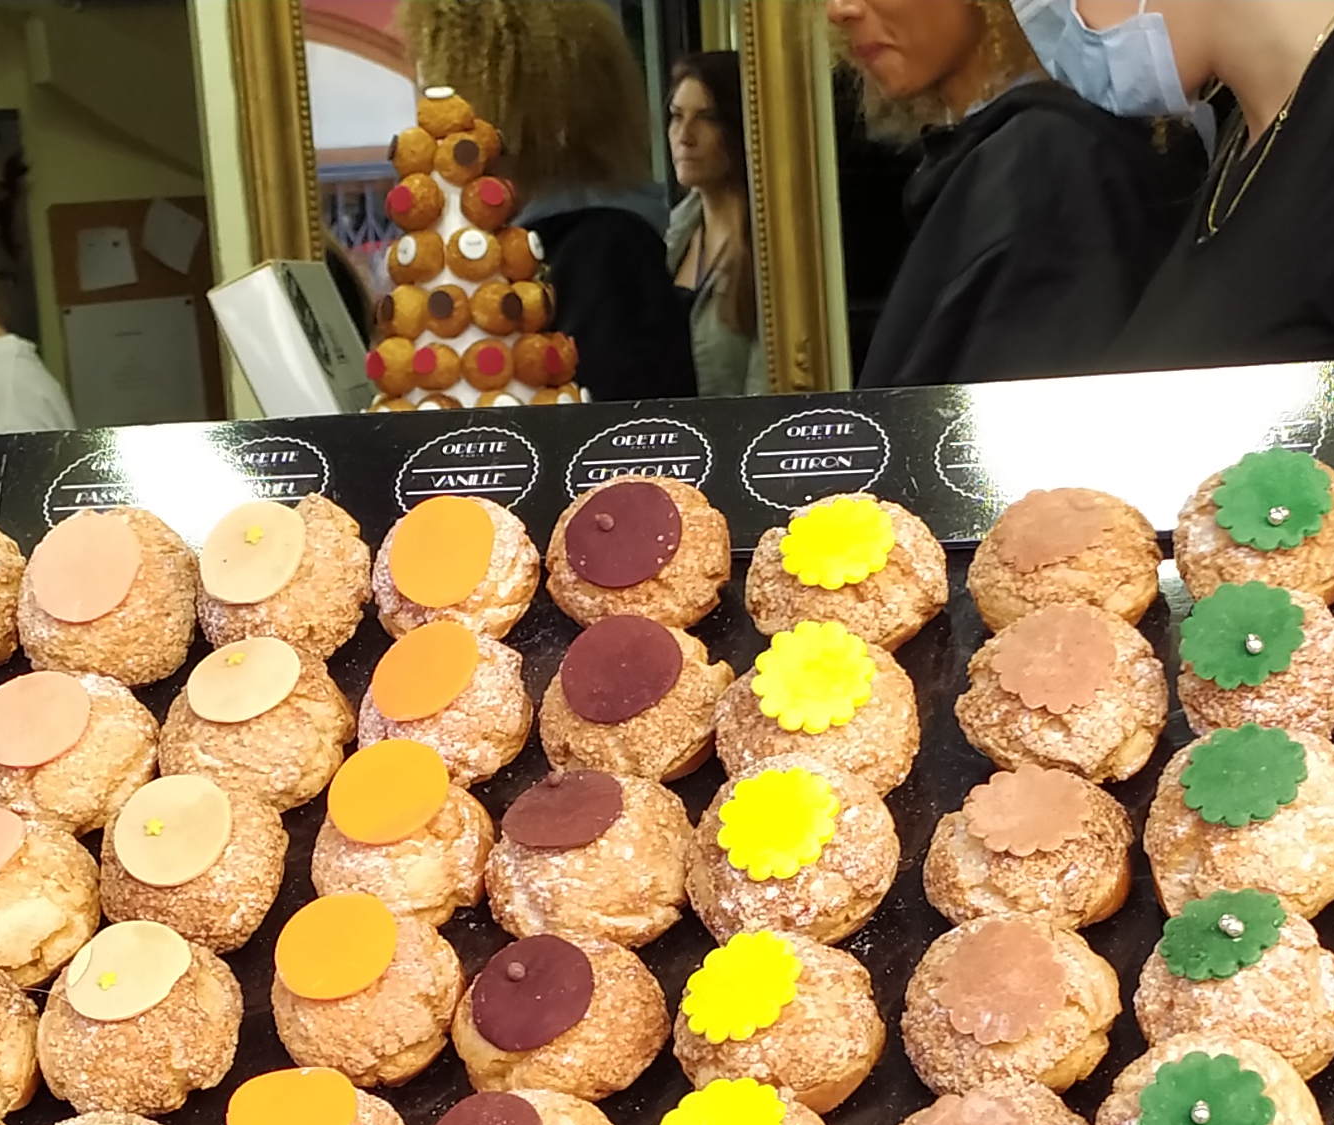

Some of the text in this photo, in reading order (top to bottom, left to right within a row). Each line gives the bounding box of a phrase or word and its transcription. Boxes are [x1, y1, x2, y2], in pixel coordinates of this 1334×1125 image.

[786, 423, 855, 438] ODETTE
[612, 432, 679, 446] ODETTE
[442, 441, 507, 455] ODETTE
[779, 455, 852, 470] CITRON
[430, 472, 506, 487] VANILLE
[588, 464, 691, 480] CHOCOLAT
